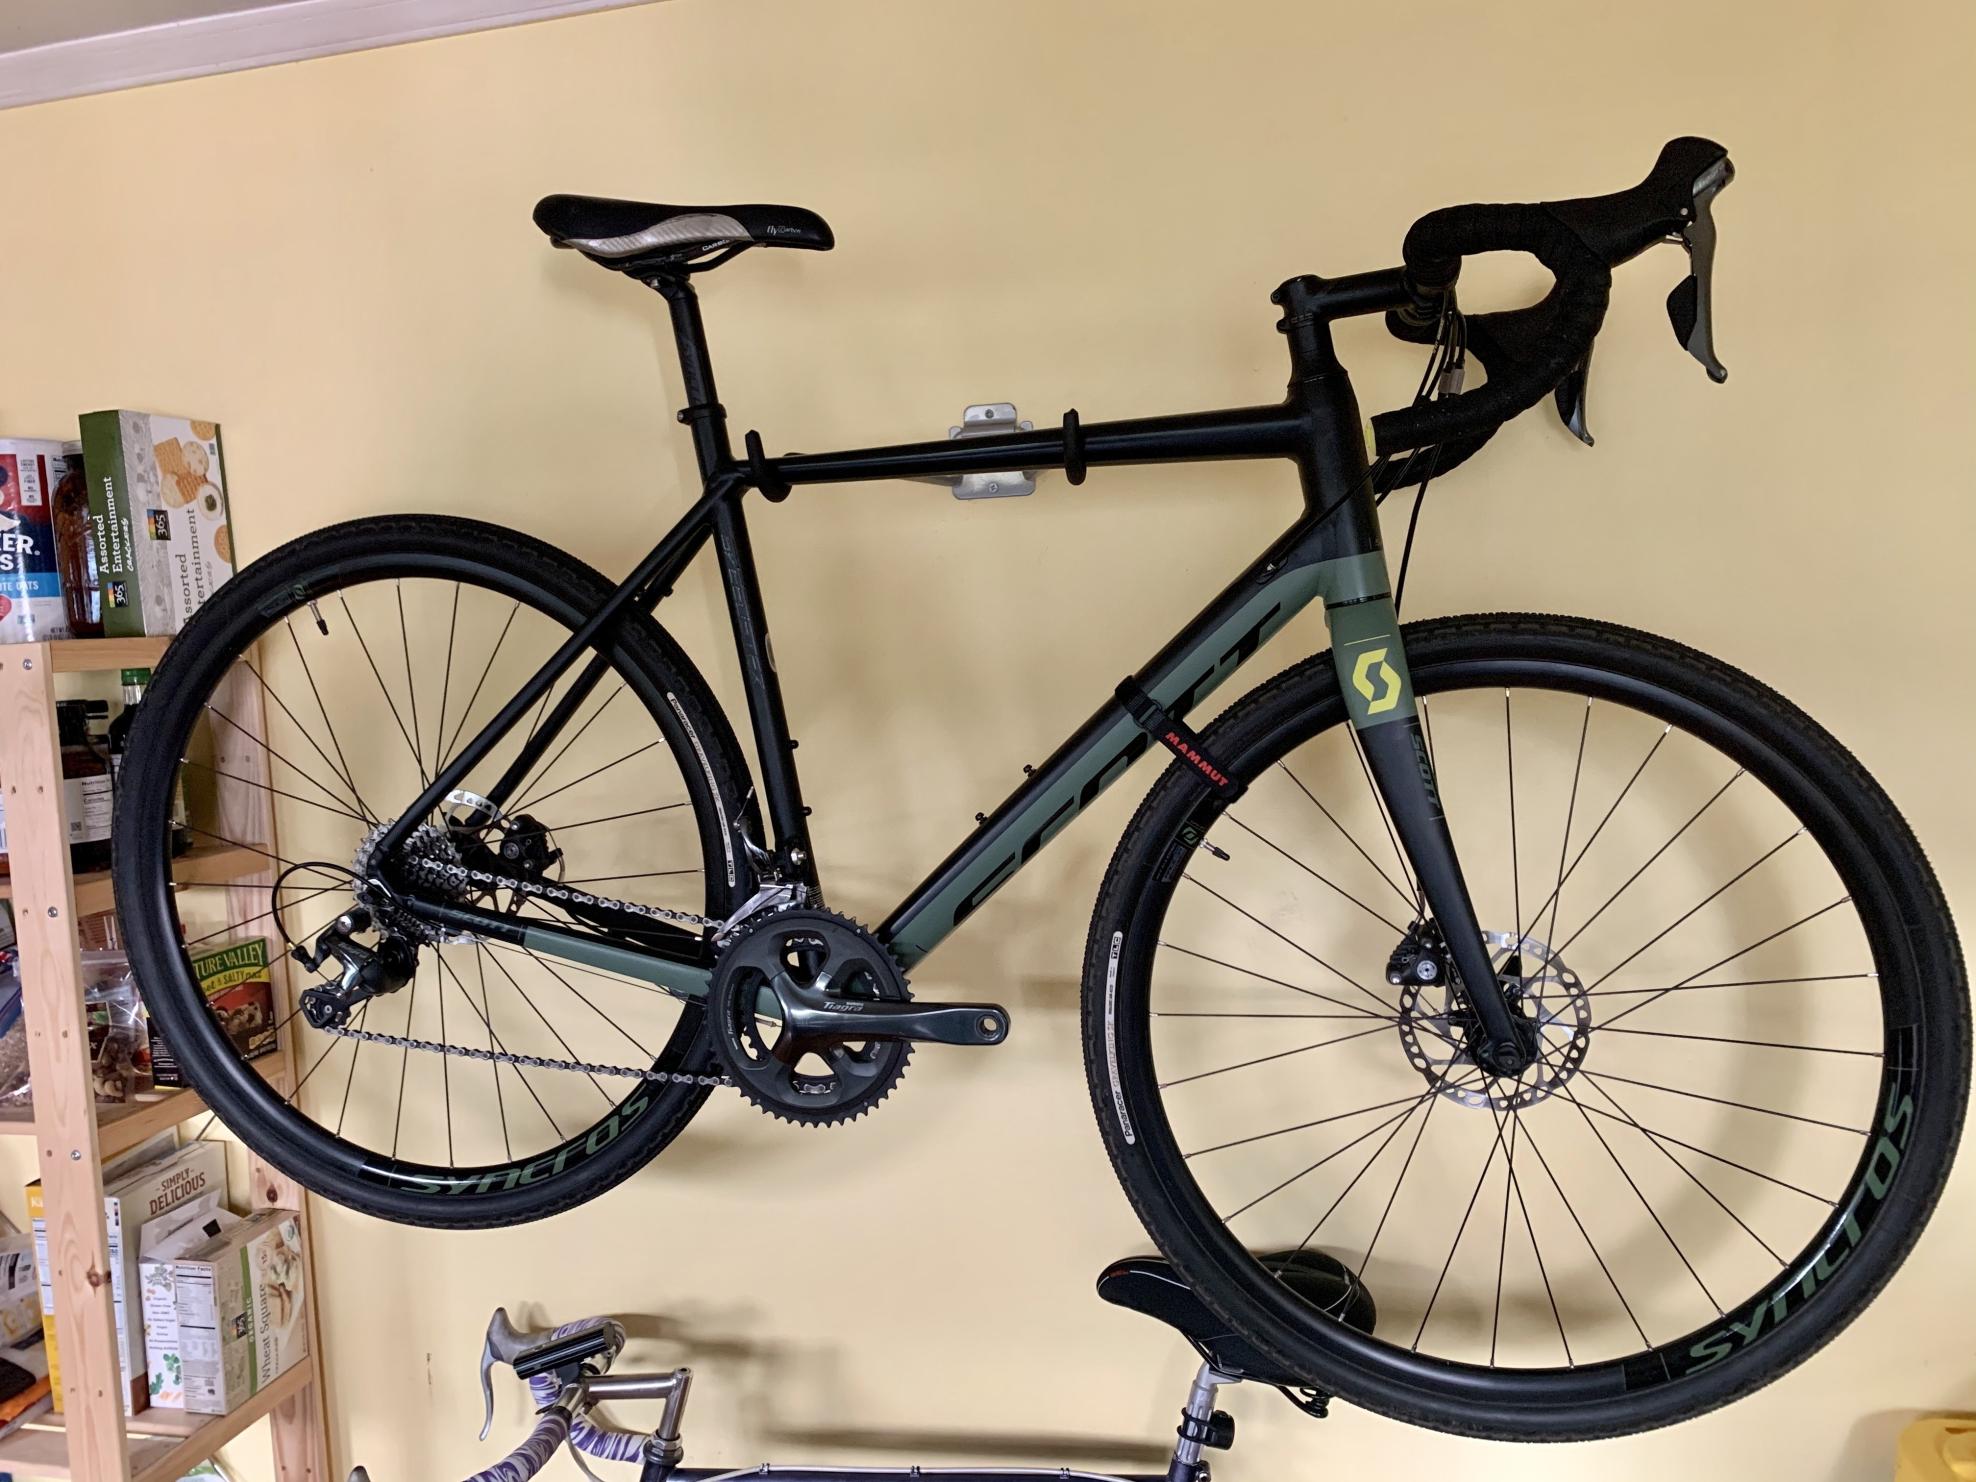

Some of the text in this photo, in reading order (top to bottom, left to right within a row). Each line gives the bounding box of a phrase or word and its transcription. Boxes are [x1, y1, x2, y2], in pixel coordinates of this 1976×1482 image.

[93, 515, 109, 574] Assorted
[104, 477, 122, 573] Entertainment
[156, 514, 168, 537] 365
[186, 509, 206, 605] tertainment
[114, 584, 125, 604] 365
[1165, 731, 1229, 786] MAMMUT
[193, 953, 224, 979] TURE
[223, 941, 264, 966] VALLEY
[824, 1001, 864, 1011] Tiagra
[1113, 1090, 1133, 1137] Panaracer
[400, 1082, 649, 1196] SYNCROS
[149, 1172, 206, 1216] DELICIOUS
[161, 1168, 190, 1192] SIMPLY
[259, 1284, 272, 1384] Wheat Square
